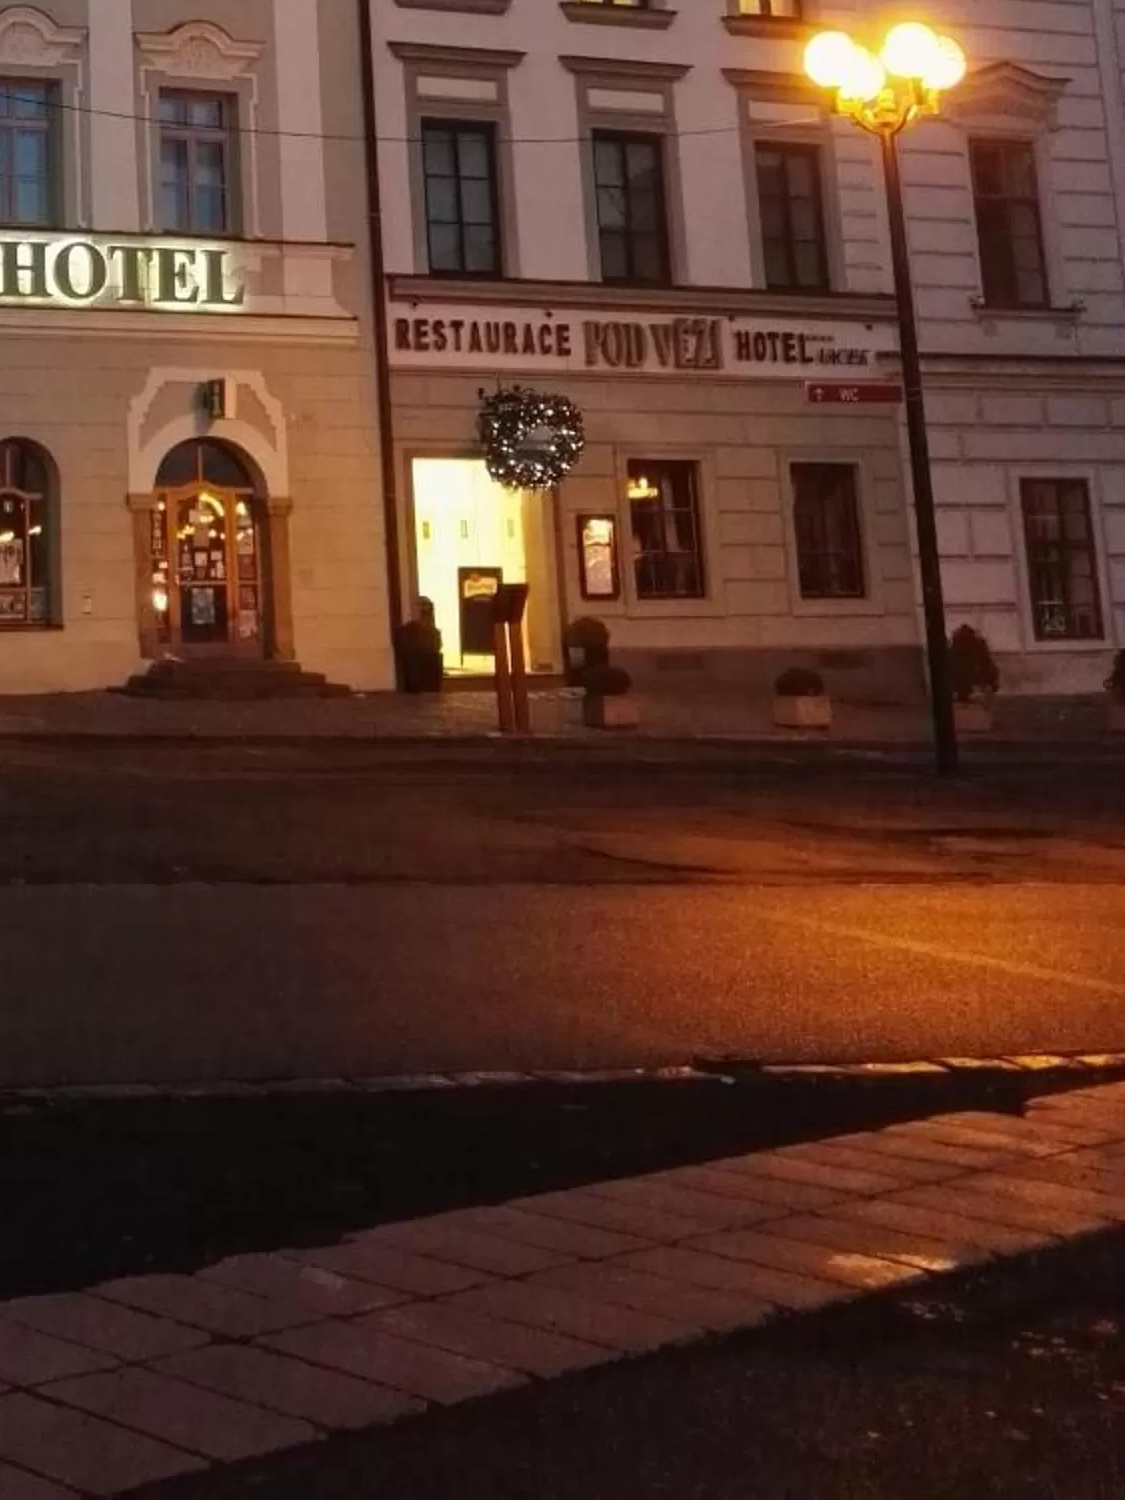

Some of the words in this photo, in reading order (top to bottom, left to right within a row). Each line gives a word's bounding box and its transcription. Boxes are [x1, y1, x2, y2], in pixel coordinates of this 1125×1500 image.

[394, 318, 572, 357] RESTAURACE
[583, 320, 647, 368] POD
[735, 329, 814, 364] HOTEL
[838, 387, 859, 404] WC
